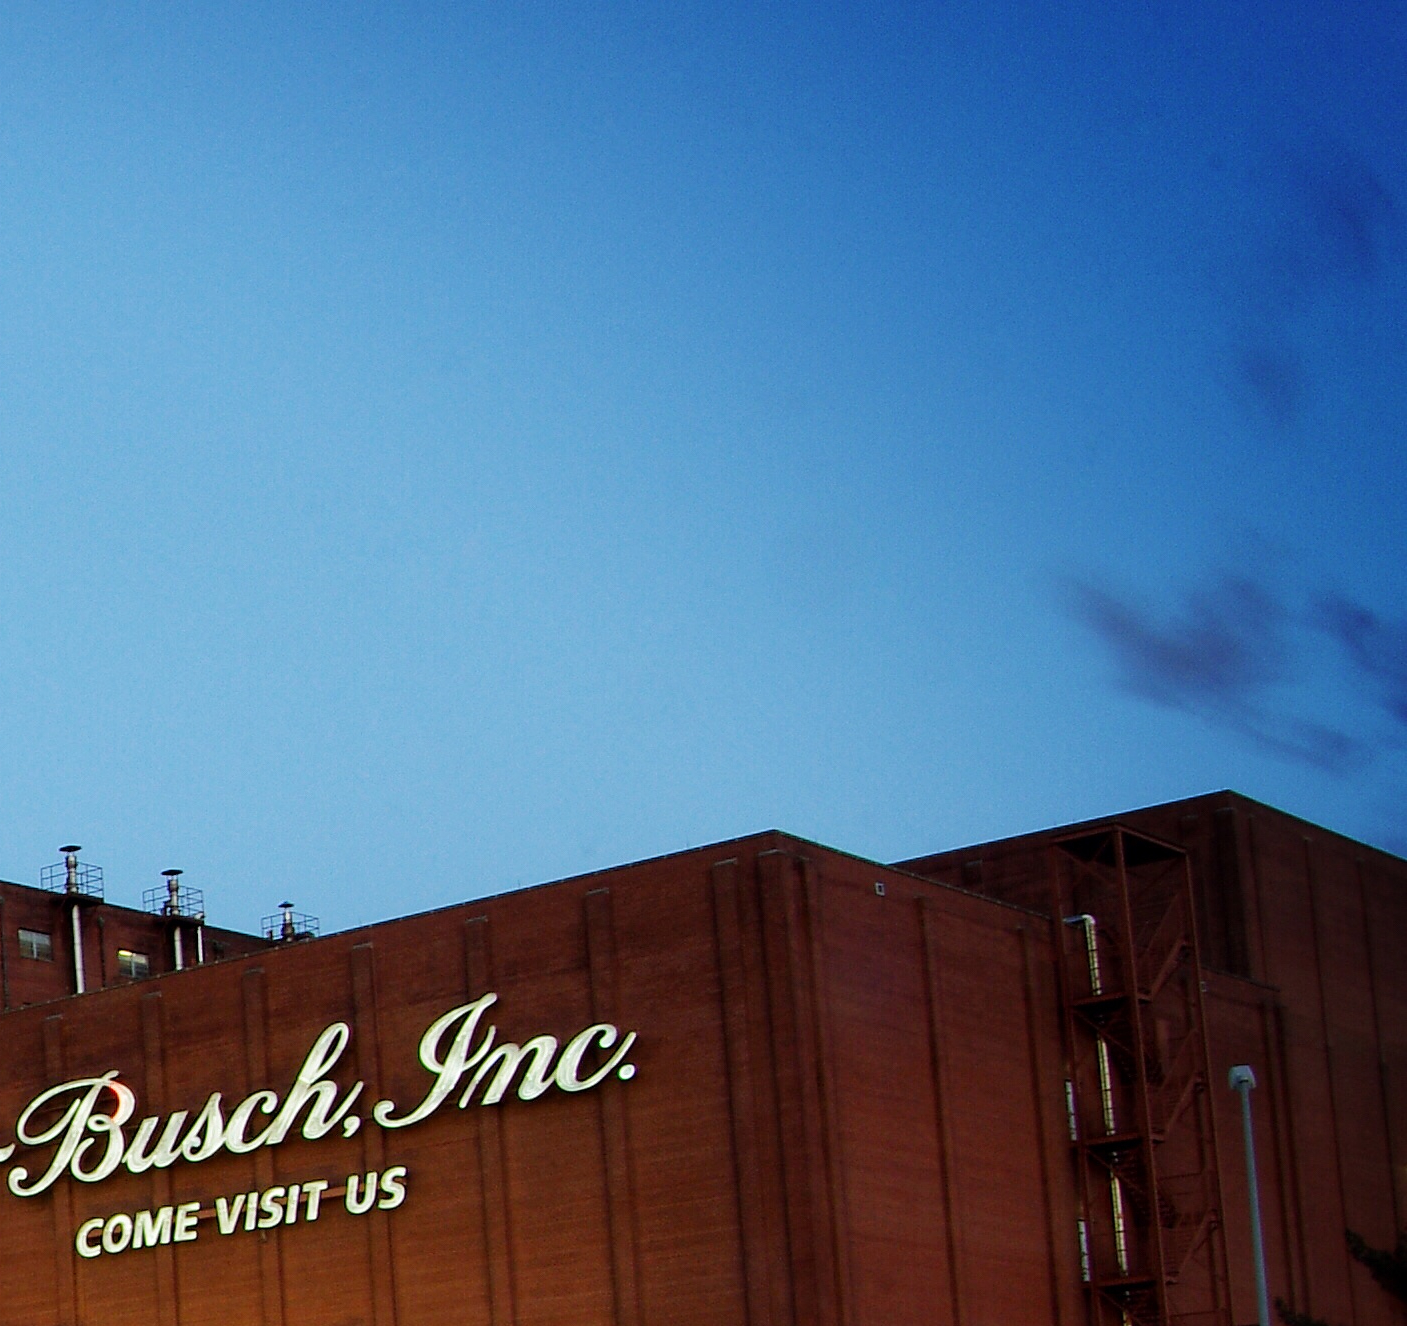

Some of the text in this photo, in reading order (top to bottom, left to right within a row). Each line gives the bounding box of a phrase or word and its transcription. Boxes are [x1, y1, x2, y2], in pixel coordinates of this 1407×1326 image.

[373, 992, 638, 1129] Inc.
[75, 1166, 407, 1258] COME VISIT US
